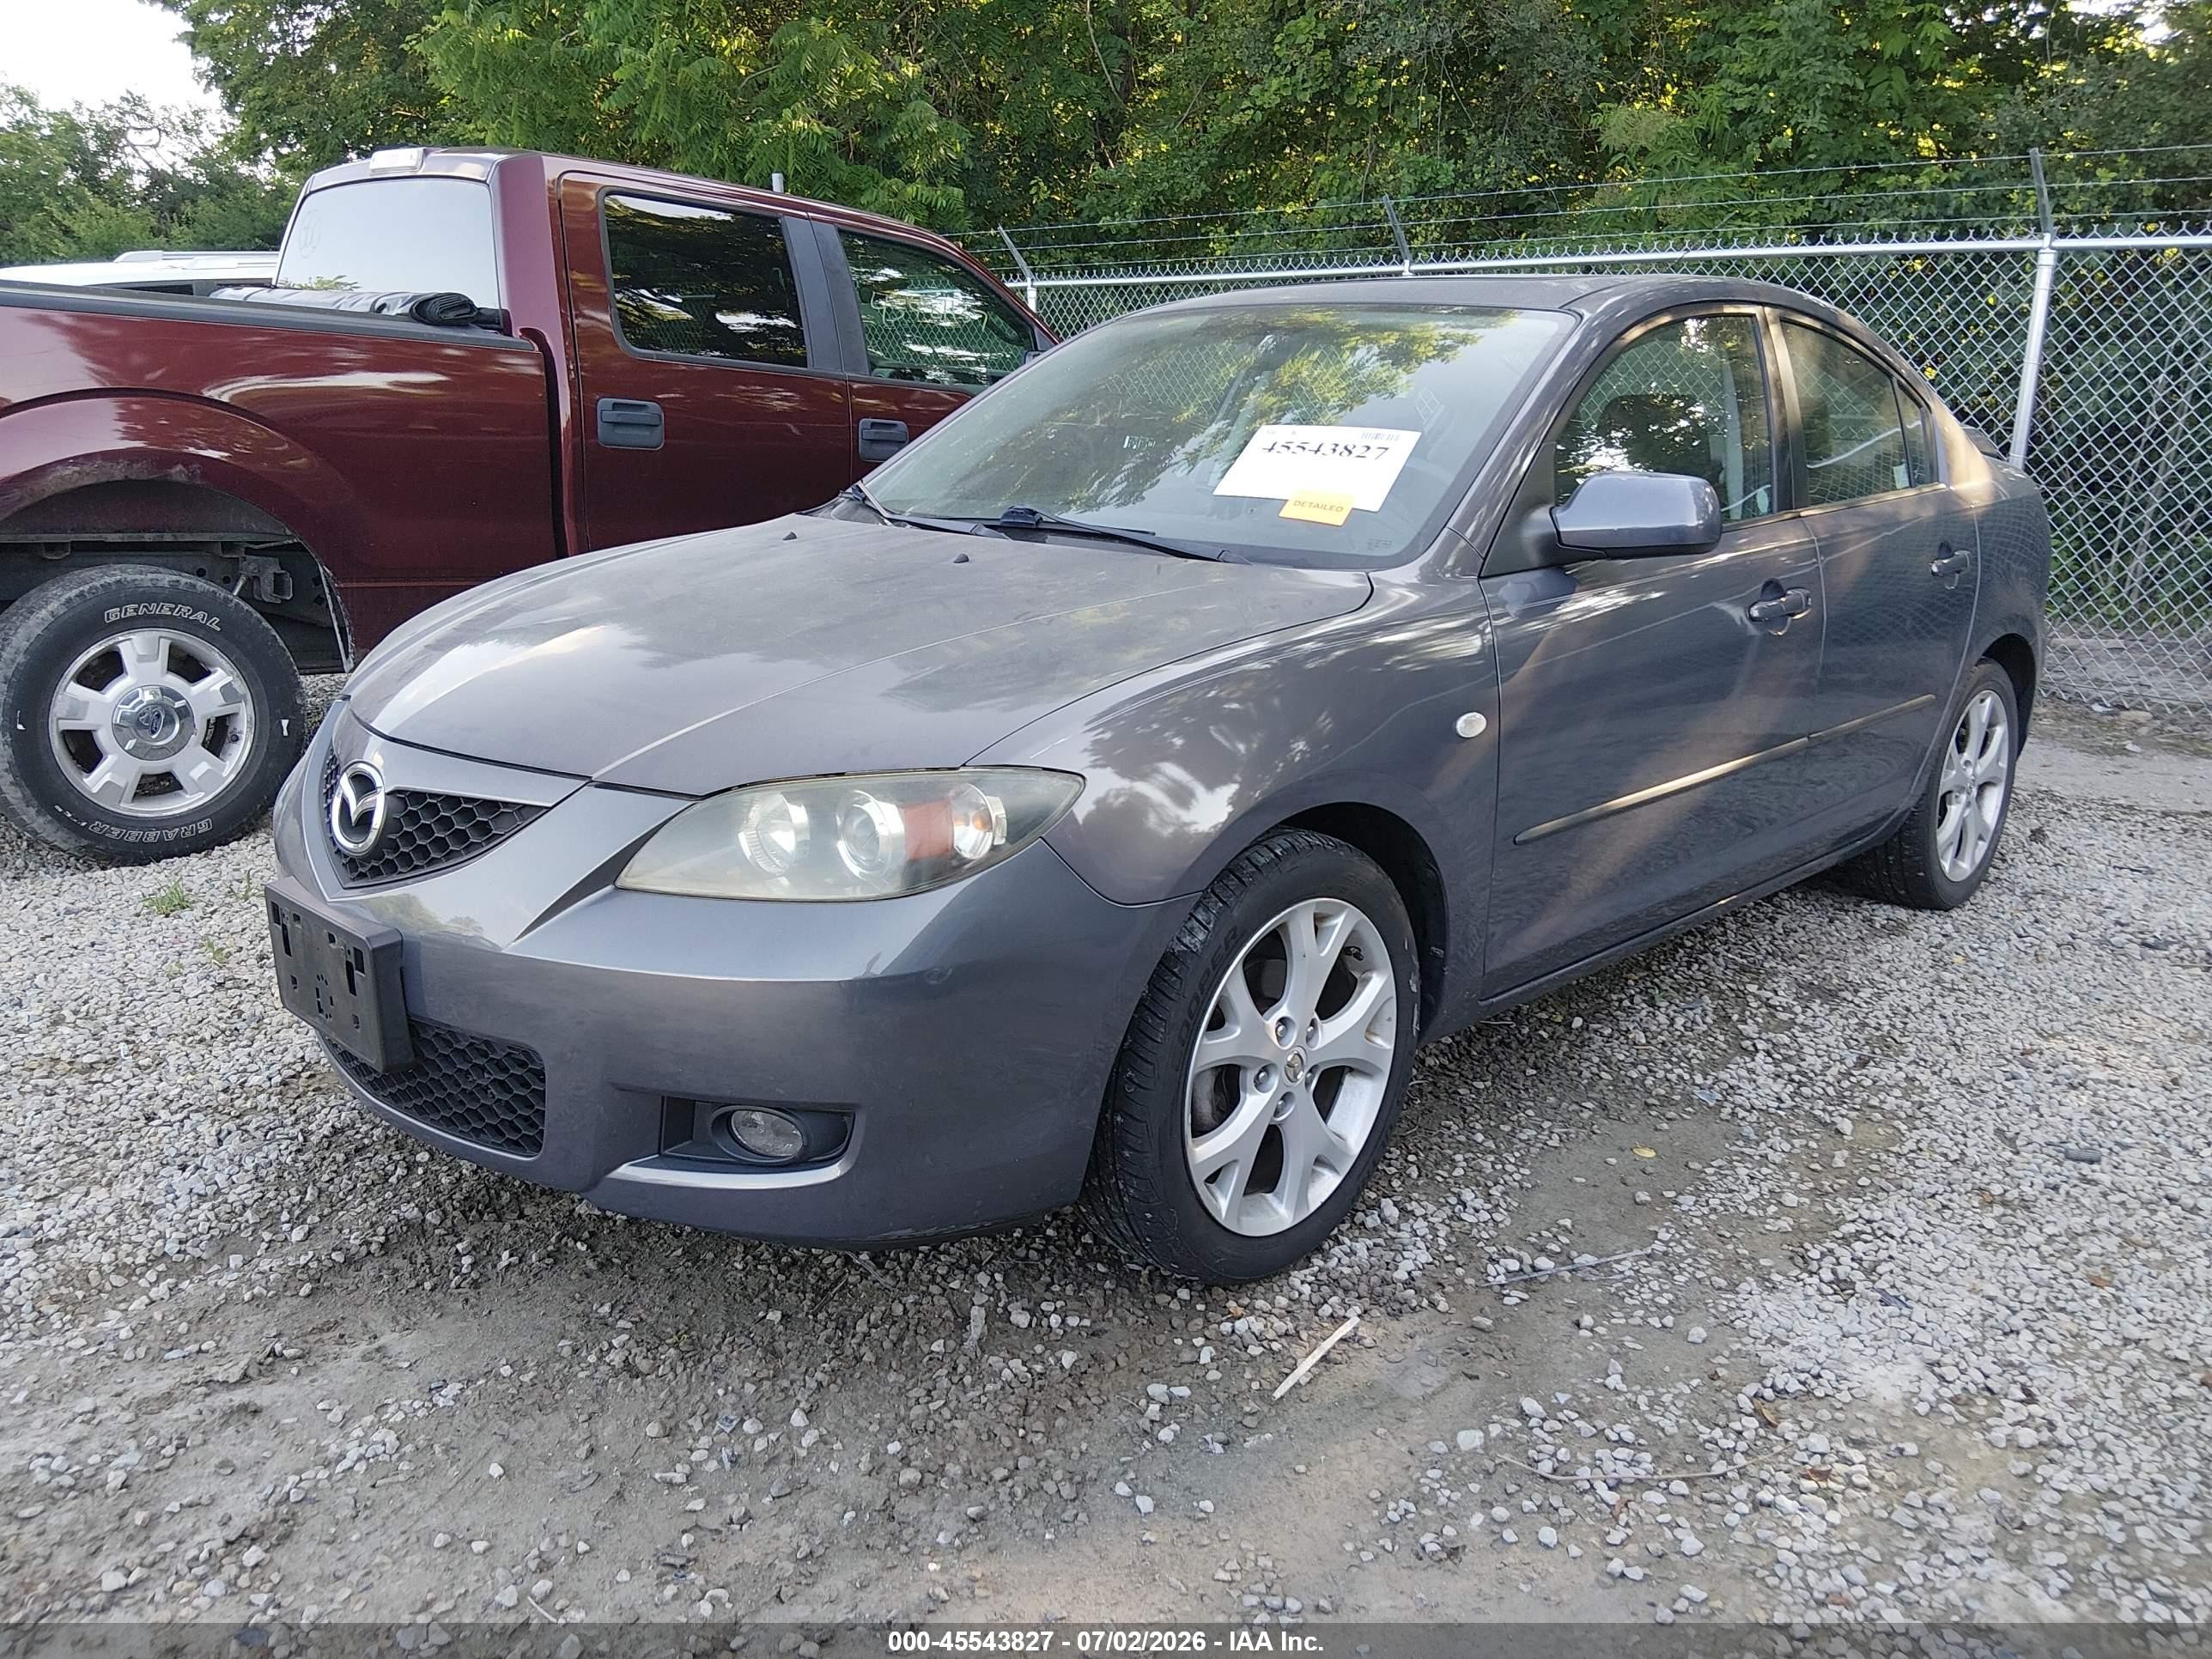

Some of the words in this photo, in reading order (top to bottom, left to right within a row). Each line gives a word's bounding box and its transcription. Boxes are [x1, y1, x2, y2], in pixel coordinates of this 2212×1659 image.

[1261, 441, 1390, 460] 45543827
[1292, 500, 1345, 514] DETAILED
[104, 602, 222, 631] GENERAL
[88, 817, 214, 843] GRABBER
